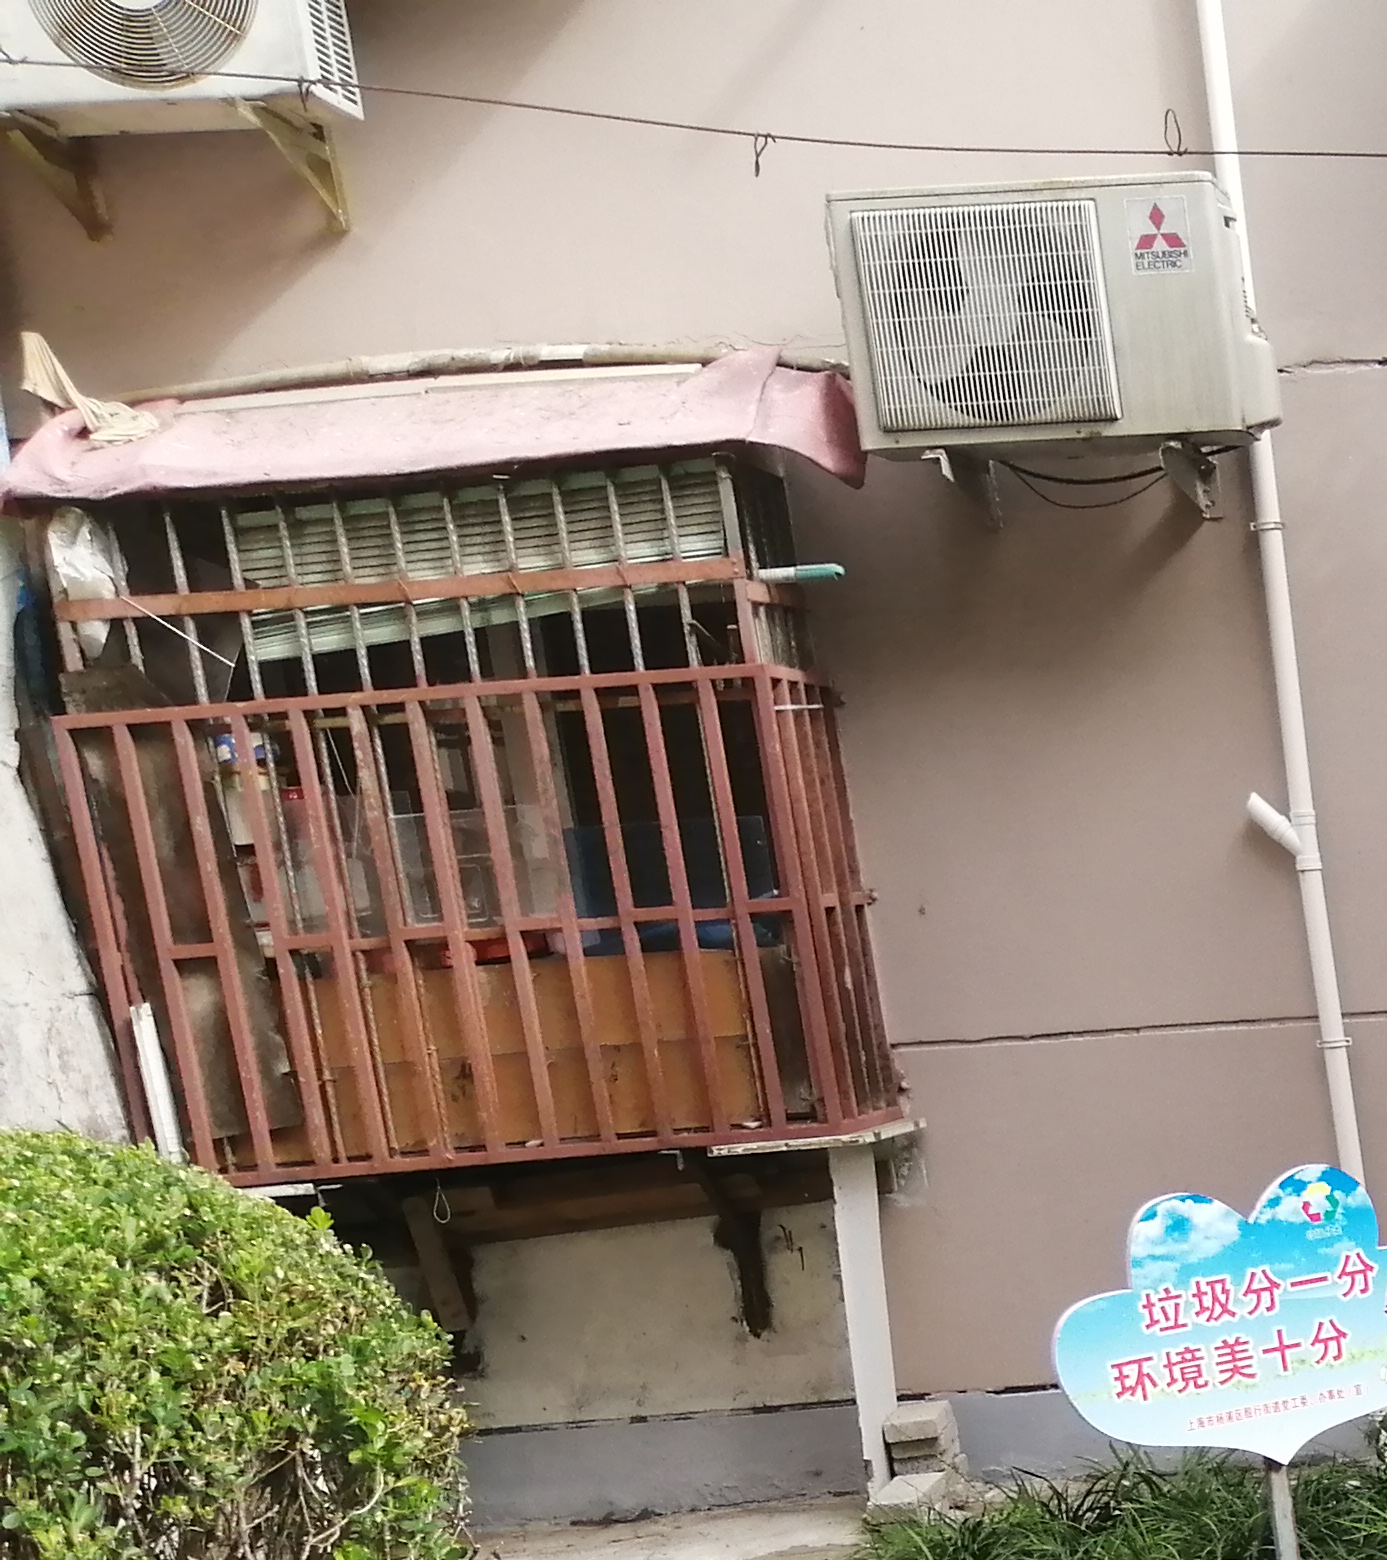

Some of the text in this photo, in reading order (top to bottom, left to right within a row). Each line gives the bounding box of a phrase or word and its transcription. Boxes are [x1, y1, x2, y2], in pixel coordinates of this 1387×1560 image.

[1135, 250, 1188, 261] MITSUBISHI
[1136, 259, 1182, 270] ELECTRIC
[1140, 1250, 1377, 1333] 垃圾分一分
[1110, 1318, 1350, 1401] 环境美十分
